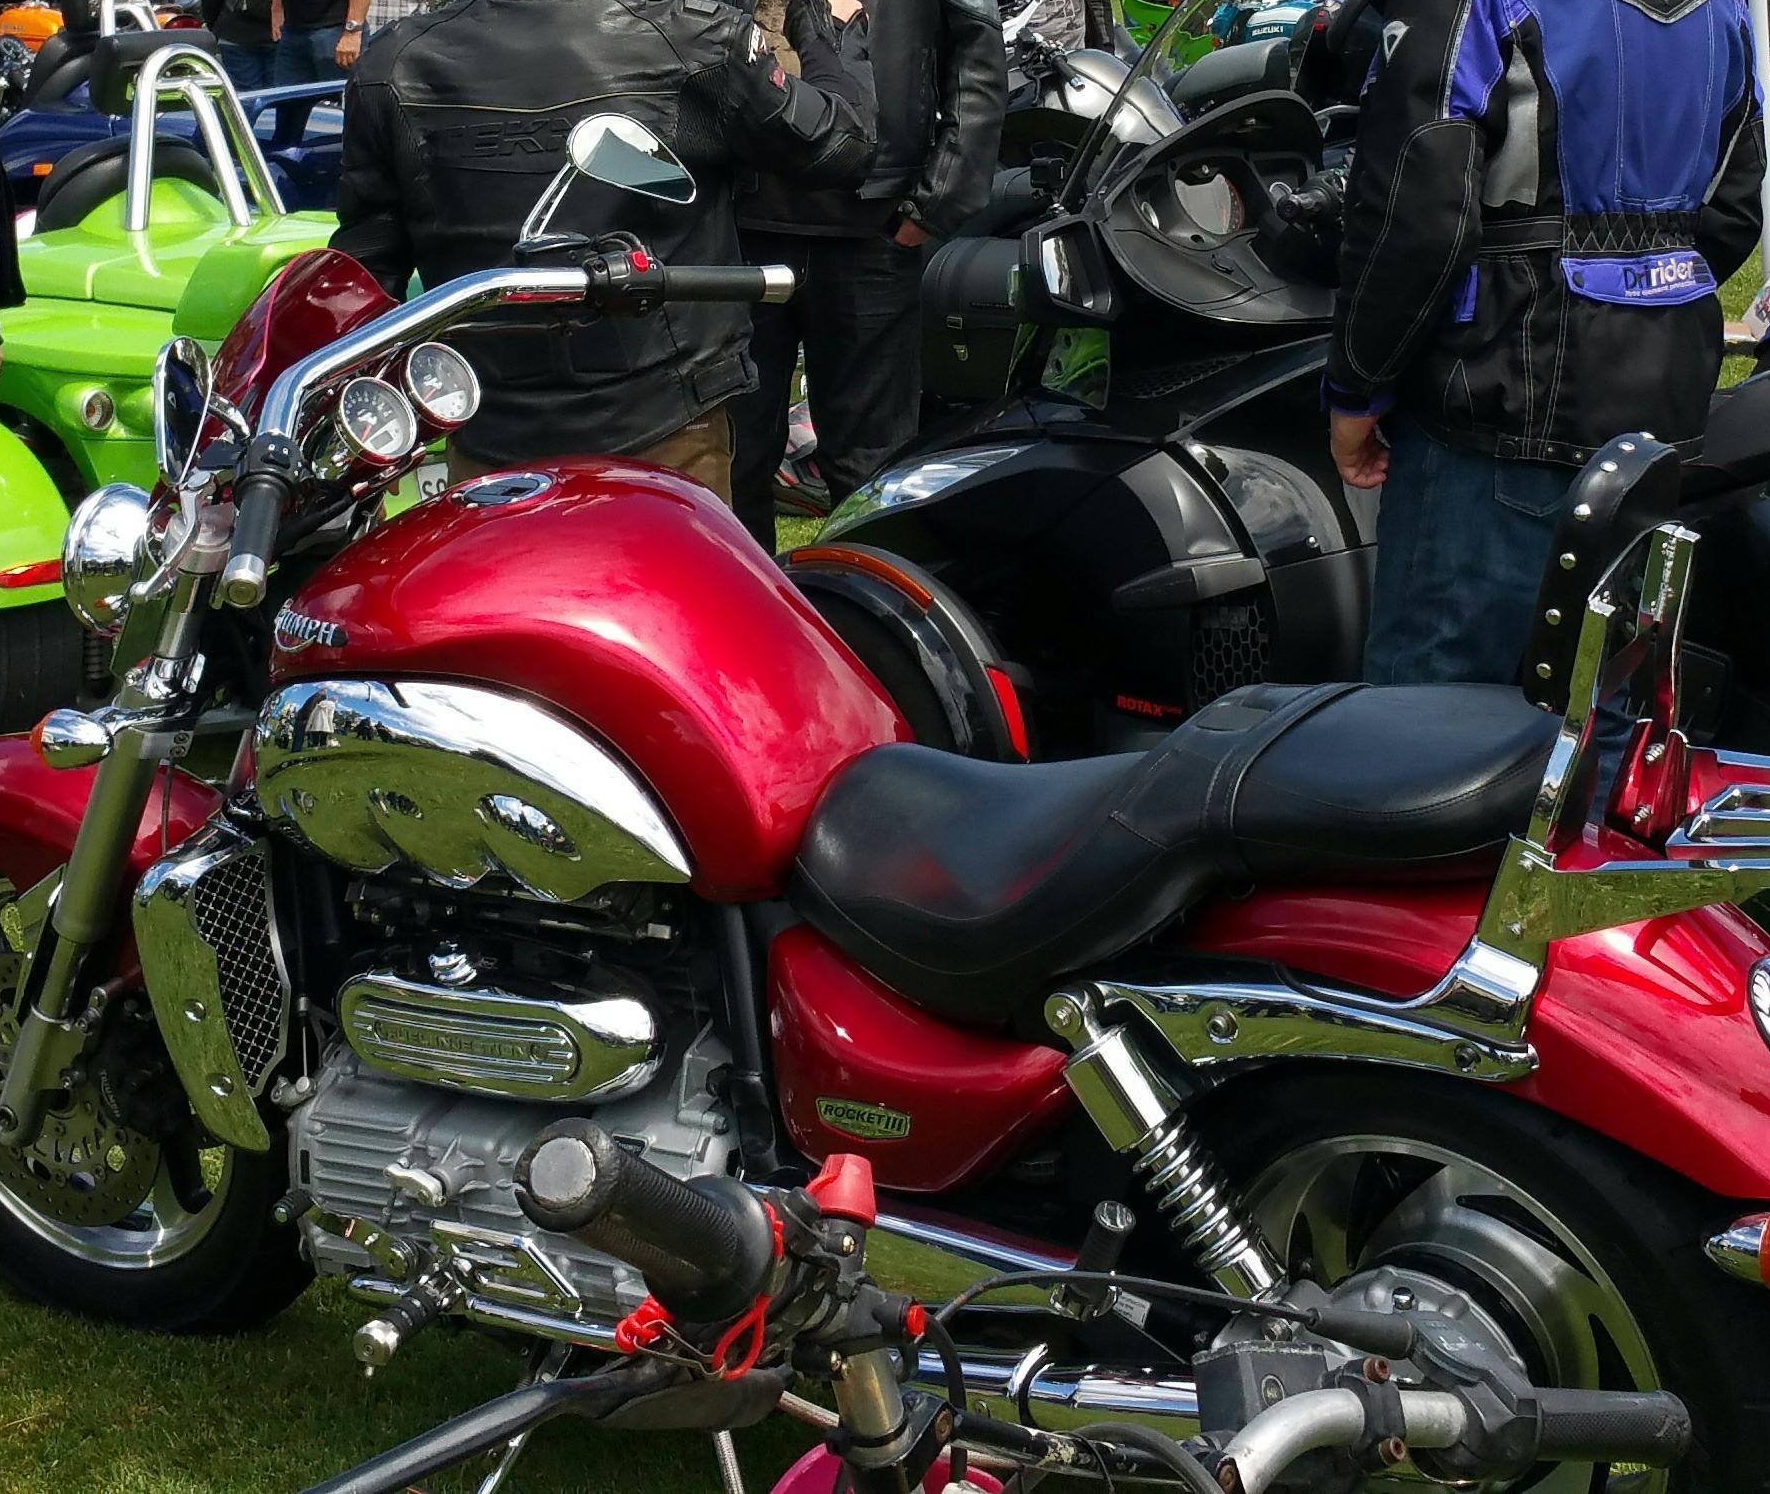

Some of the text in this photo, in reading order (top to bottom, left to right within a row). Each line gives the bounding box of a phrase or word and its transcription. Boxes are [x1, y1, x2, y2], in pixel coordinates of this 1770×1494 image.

[1252, 25, 1284, 37] SUZUKI
[1117, 695, 1163, 717] ROTAX
[823, 1104, 885, 1125] ROCKET
[884, 1116, 904, 1131] III
